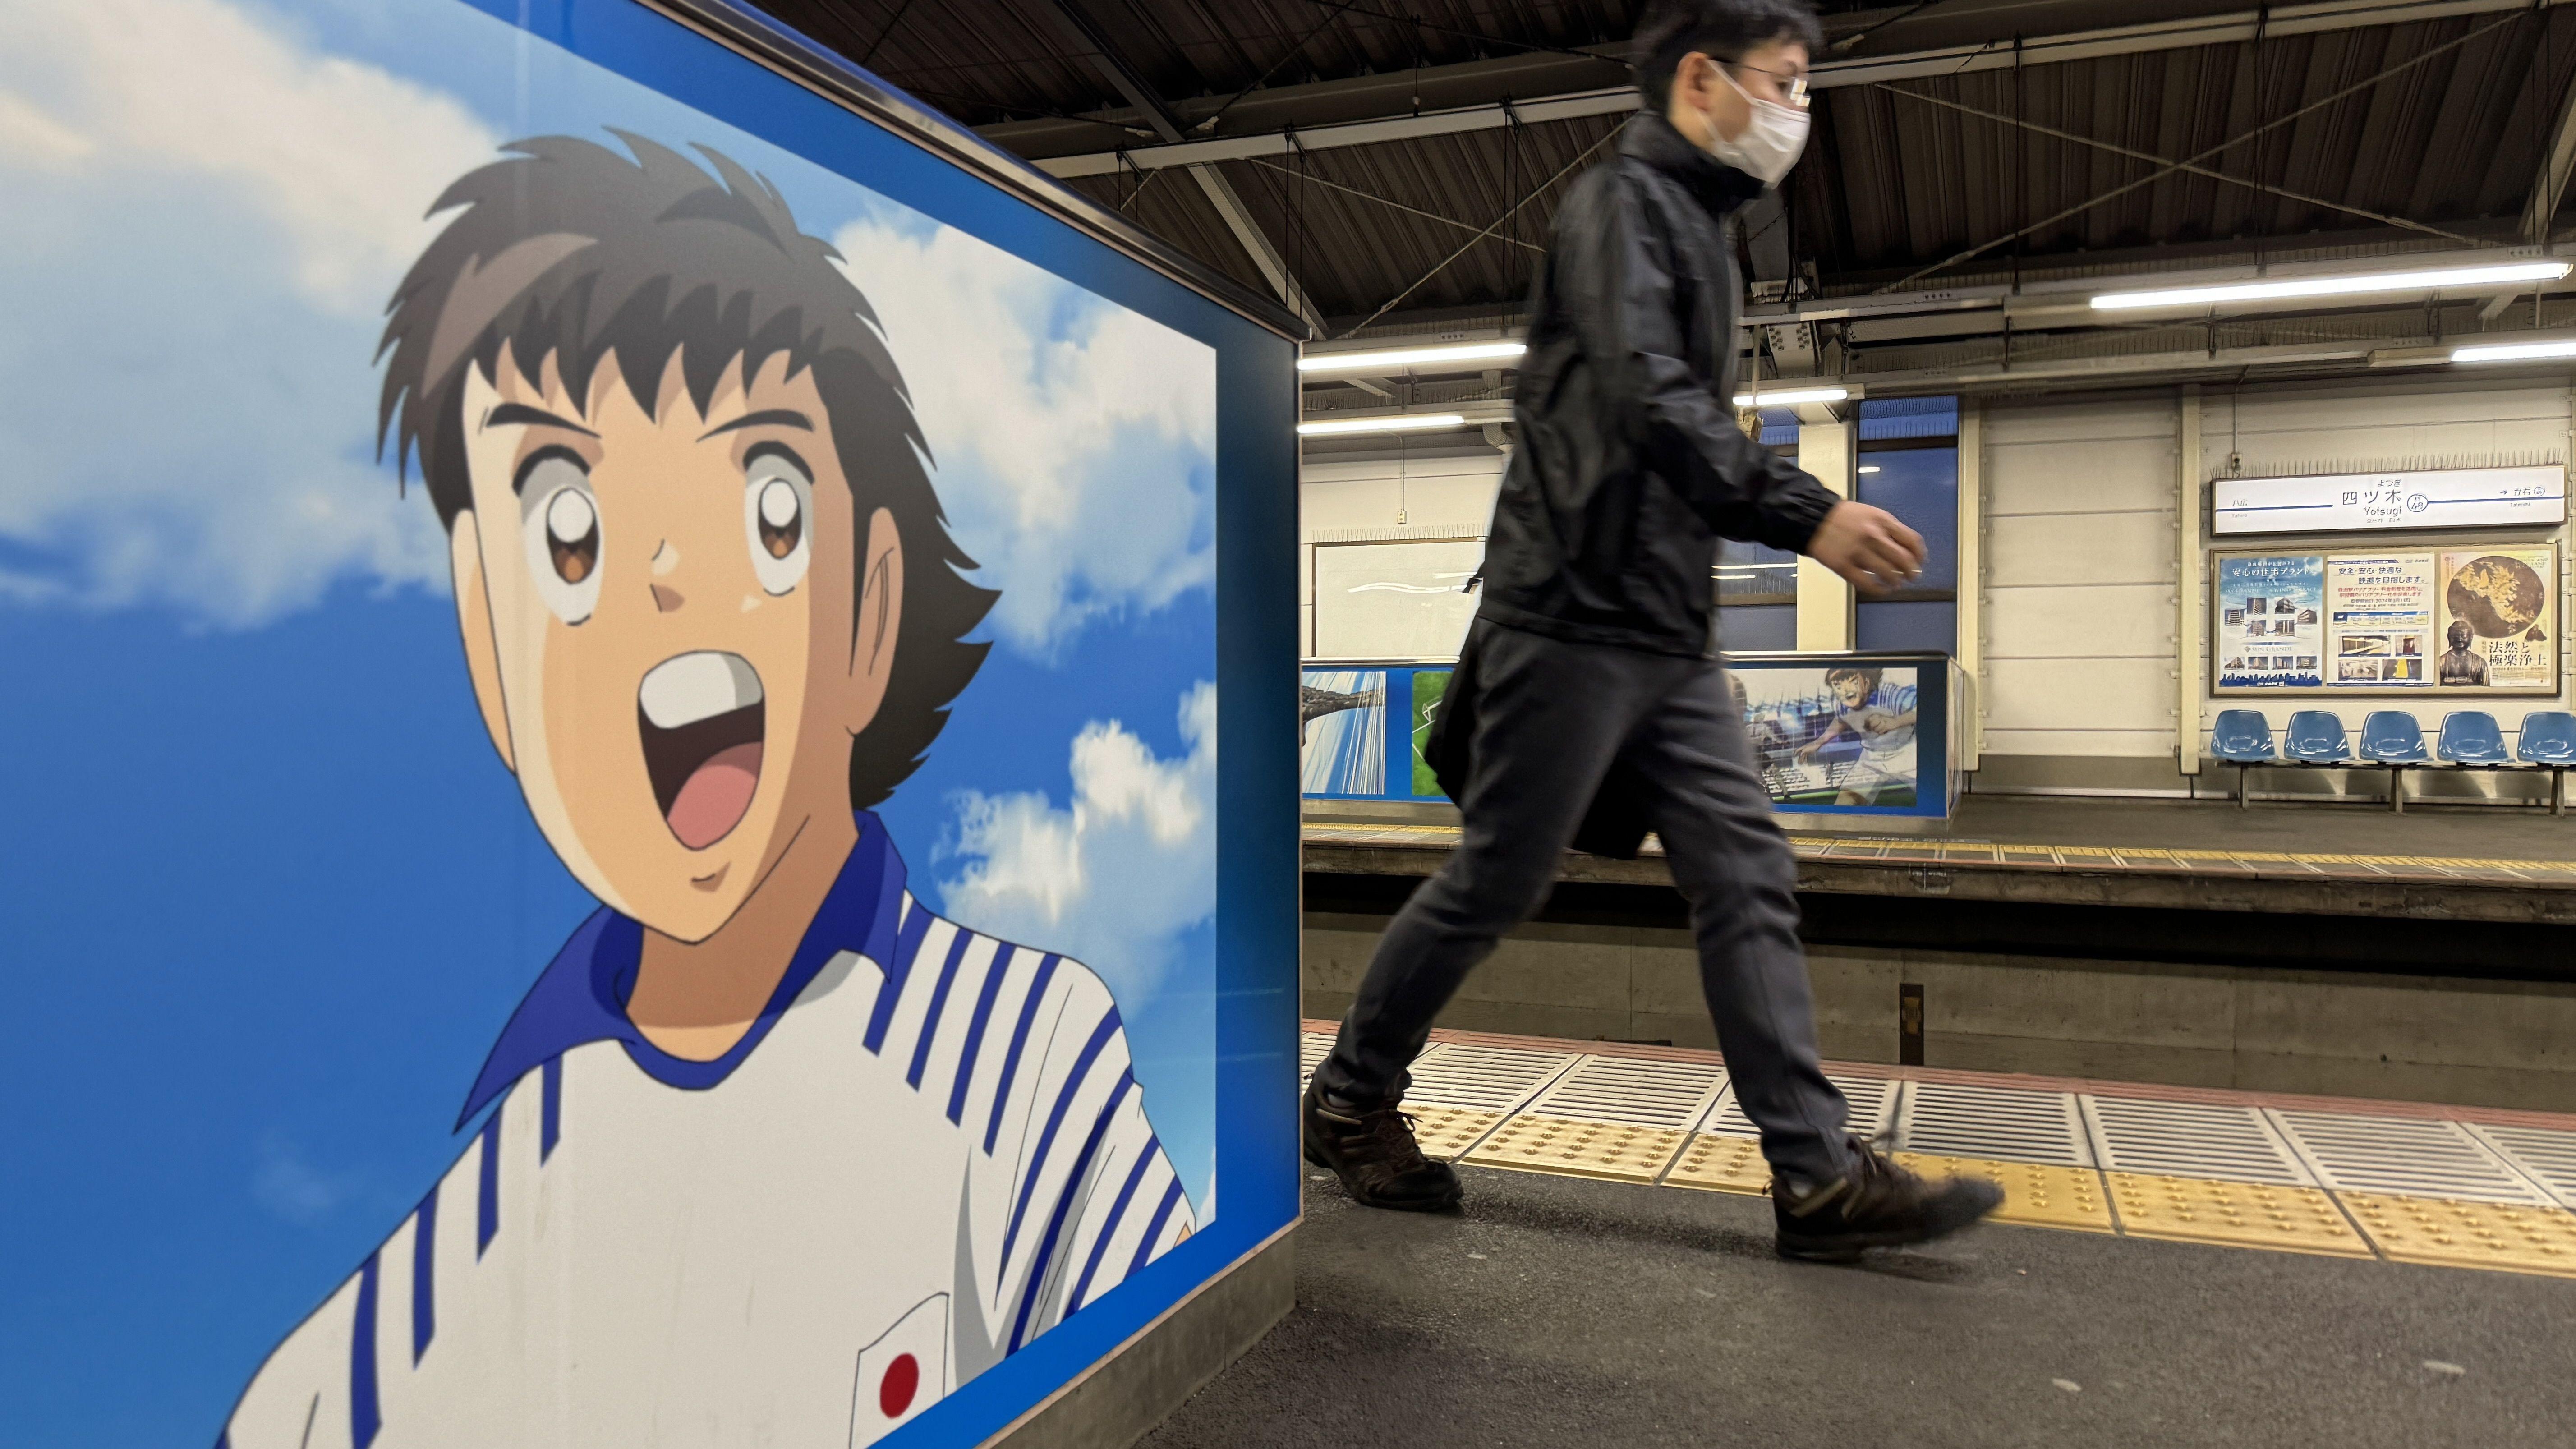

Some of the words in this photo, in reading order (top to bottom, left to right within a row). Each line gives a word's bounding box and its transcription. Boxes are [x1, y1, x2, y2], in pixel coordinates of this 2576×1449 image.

[2343, 489, 2401, 505] 四ツ木
[2364, 505, 2401, 517] Yotsugi
[2489, 641, 2530, 653] 法然と
[2489, 653, 2547, 666] 極楽浄土
